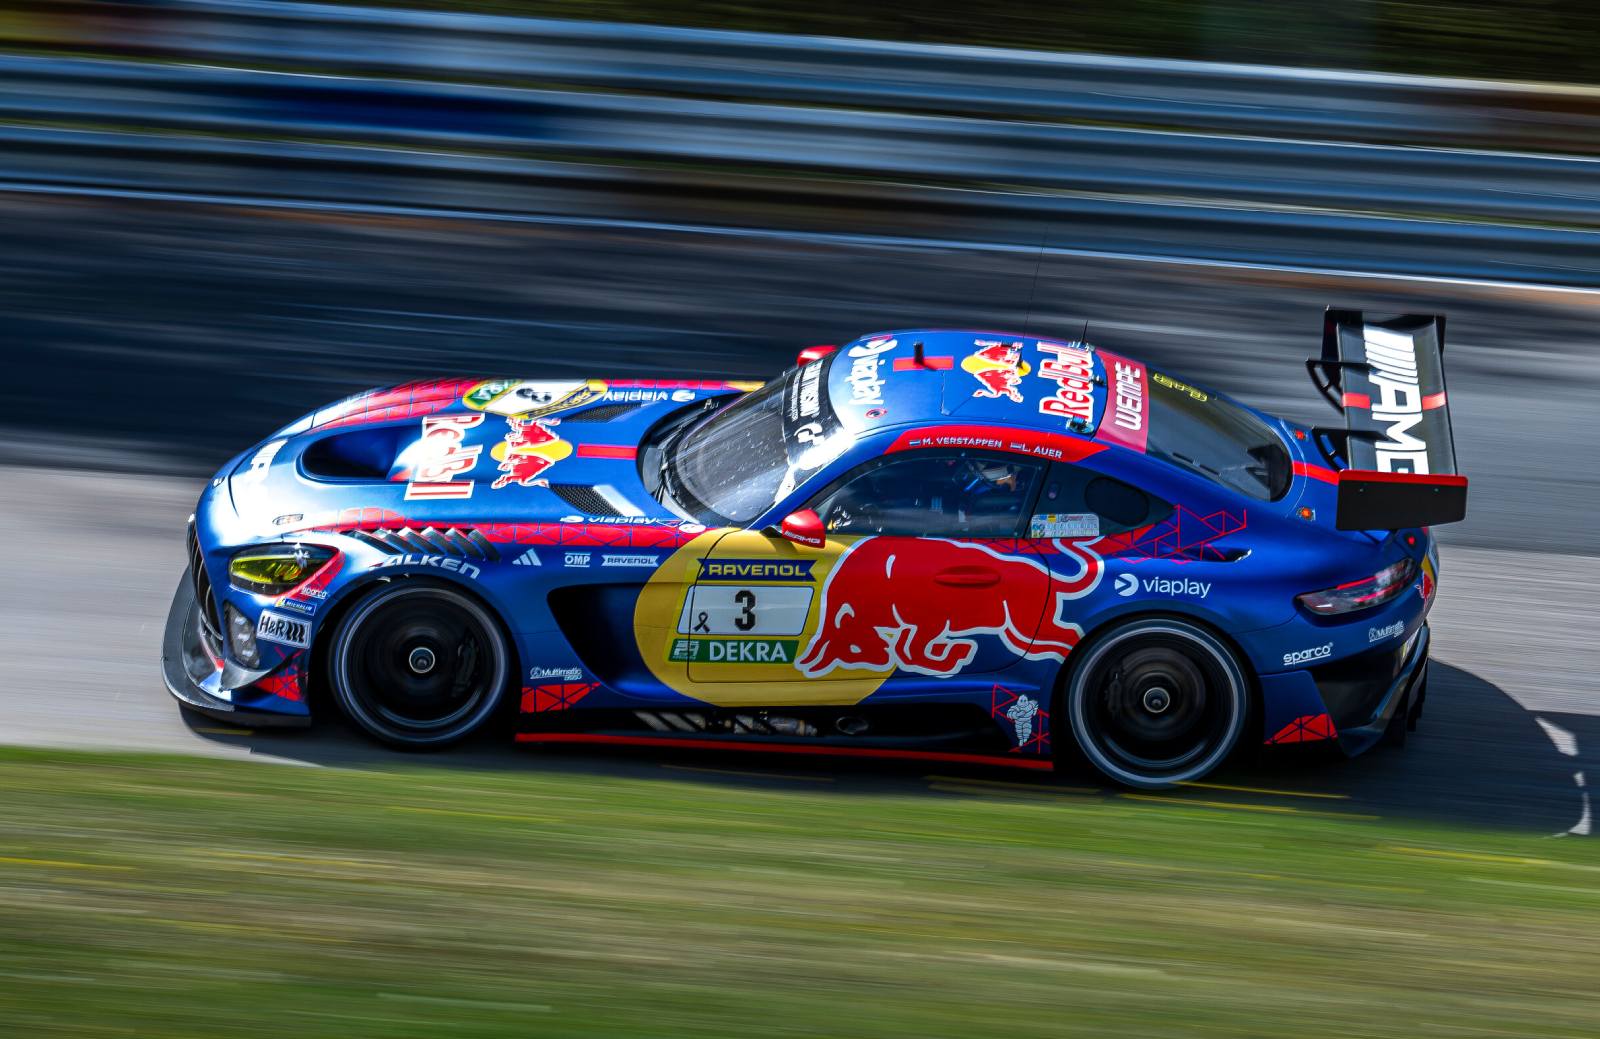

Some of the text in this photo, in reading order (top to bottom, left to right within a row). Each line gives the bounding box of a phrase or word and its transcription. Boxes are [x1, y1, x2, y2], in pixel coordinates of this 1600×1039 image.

[1115, 361, 1143, 431] WEMPE
[1368, 374, 1429, 475] AMG
[922, 436, 1063, 459] M. VERSTAPPEN L. AUER
[370, 553, 481, 580] ALKEN
[564, 554, 590, 565] OMP
[606, 556, 653, 565] RAVENOL
[708, 563, 806, 578] RAVENOL
[1142, 576, 1211, 599] viaplay
[734, 590, 756, 631] 3
[259, 614, 285, 637] H&R
[709, 641, 787, 662] DEKRA
[1283, 644, 1332, 665] sparco
[542, 667, 582, 677] Multimatic
